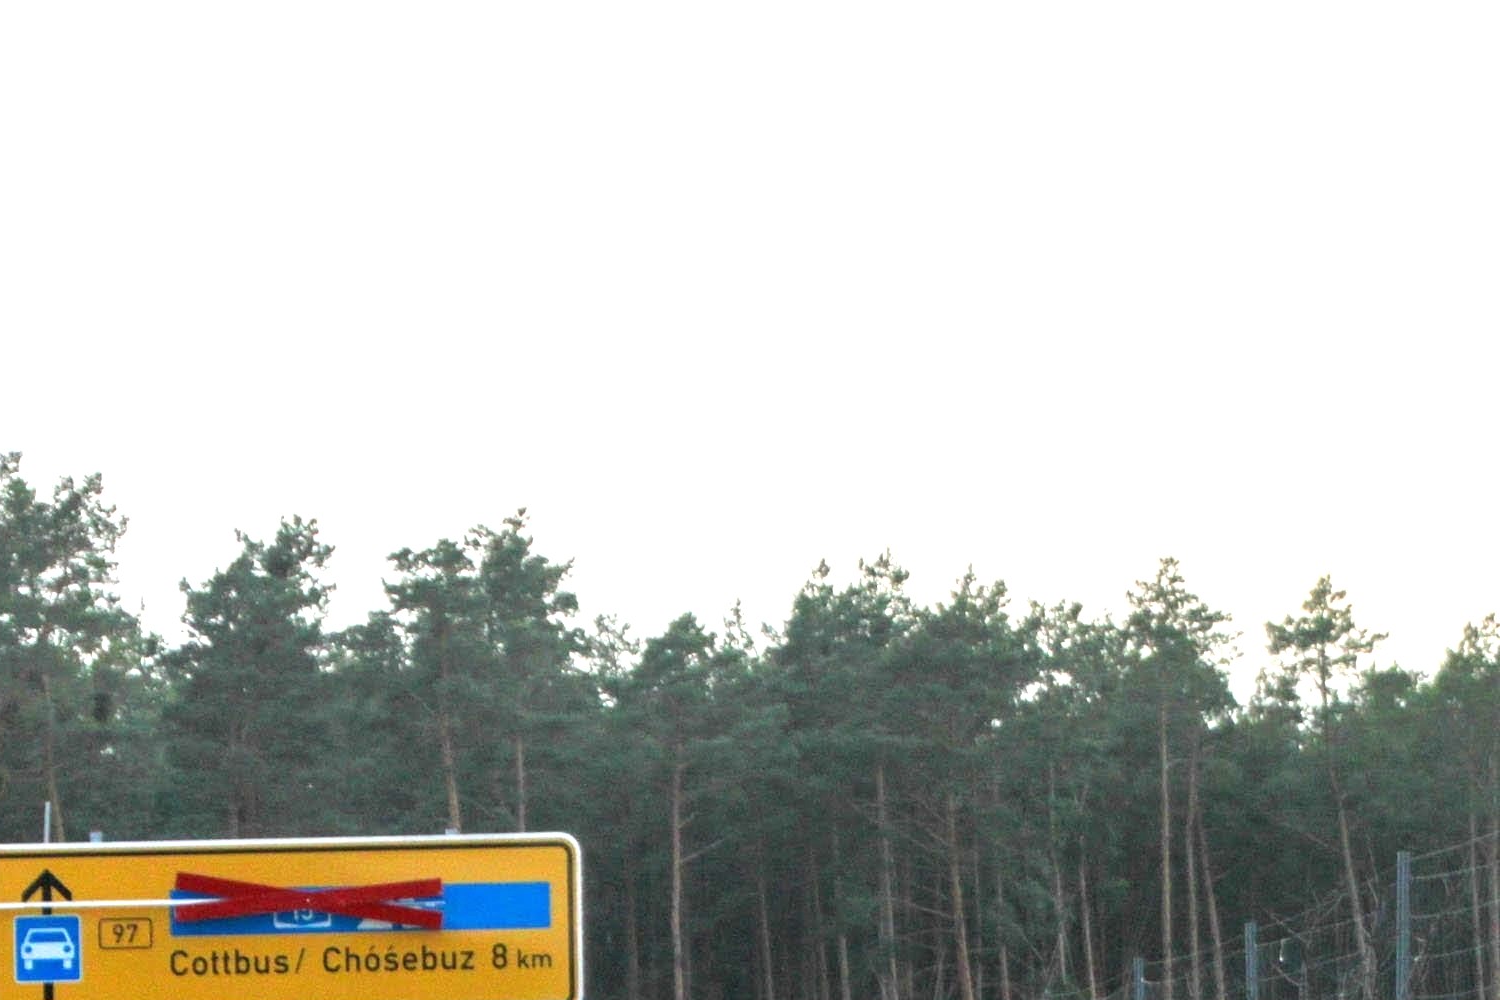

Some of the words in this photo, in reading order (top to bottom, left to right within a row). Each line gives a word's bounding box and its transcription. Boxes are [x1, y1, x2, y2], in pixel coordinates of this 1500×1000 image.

[112, 923, 138, 944] 97
[170, 948, 305, 977] Cottbus/
[322, 945, 475, 972] Chóśebuz
[492, 943, 508, 970] 8
[516, 948, 553, 969] km
